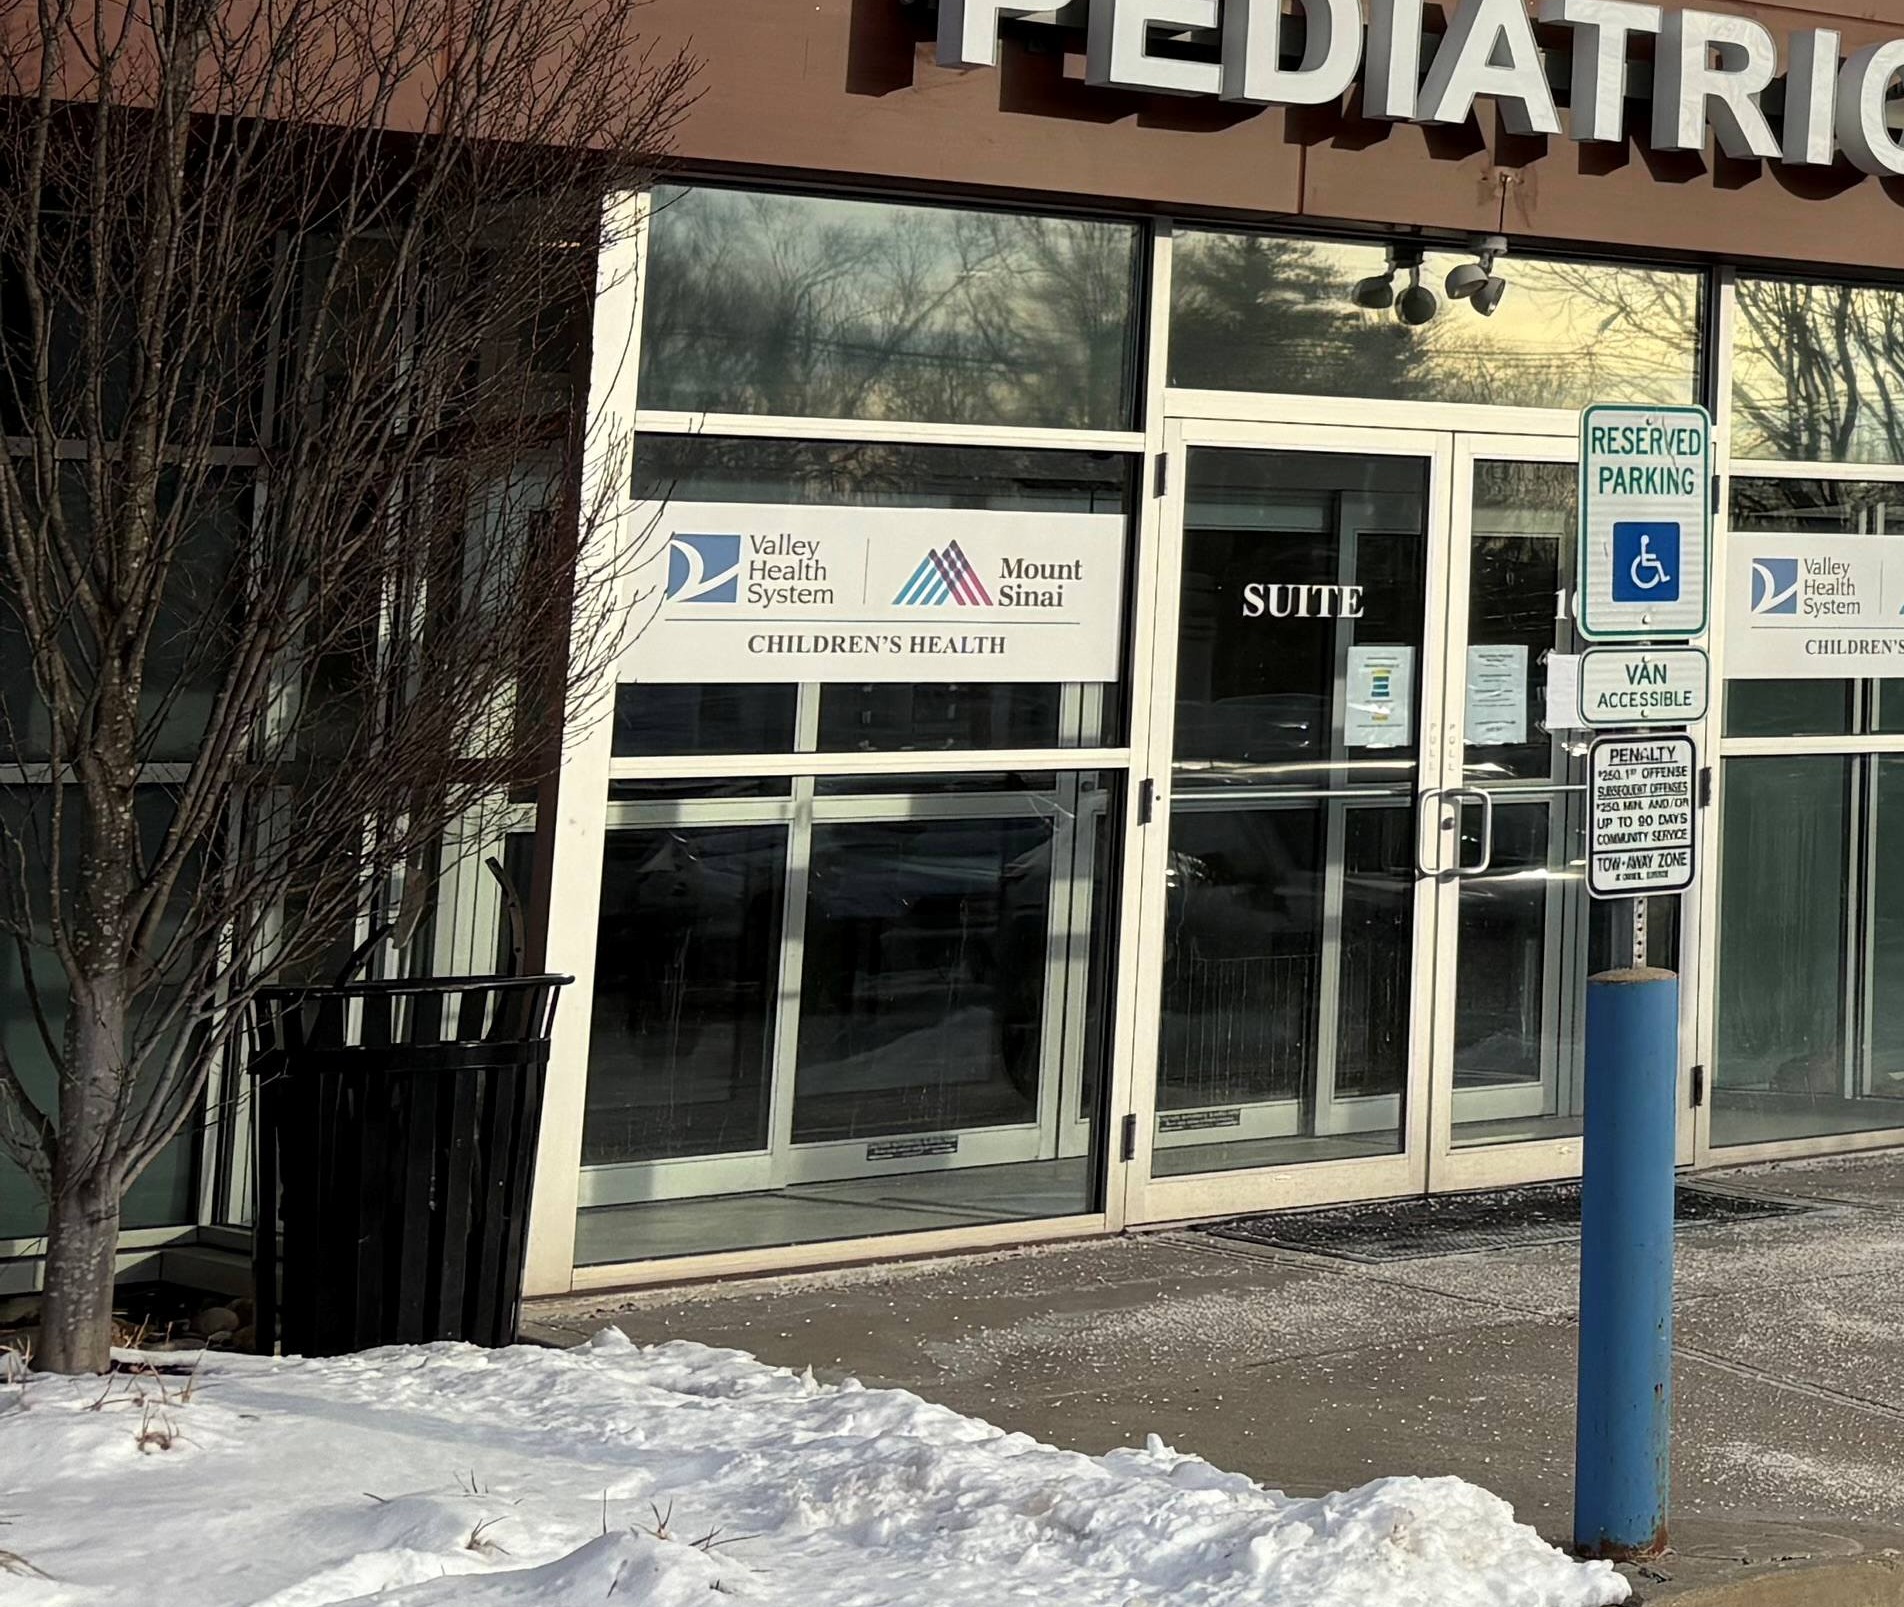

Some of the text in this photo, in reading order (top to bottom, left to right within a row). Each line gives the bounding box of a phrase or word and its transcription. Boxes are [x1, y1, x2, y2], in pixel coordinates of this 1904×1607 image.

[1591, 426, 1701, 456] RESERVED
[1599, 466, 1695, 495] PARKING
[749, 533, 821, 560] Valley
[748, 558, 828, 582] Health
[999, 556, 1083, 581] Mount
[1803, 556, 1851, 579] Valley
[747, 582, 834, 608] System
[997, 583, 1064, 608] Sinai
[1803, 578, 1856, 596] Health
[1242, 583, 1365, 618] SUITE
[1803, 597, 1861, 618] System
[747, 633, 1007, 655] CHILDREN'S HEALTH
[1625, 662, 1667, 686] VAN
[1597, 690, 1692, 708] ACCESSIBLE
[1609, 746, 1676, 763] PENALTY
[1641, 765, 1688, 779] OFFENSE
[1597, 812, 1688, 830] UP TO 90 DAYS
[1597, 828, 1688, 845] COMMUNITY SERVICE
[1657, 851, 1688, 869] ZONE
